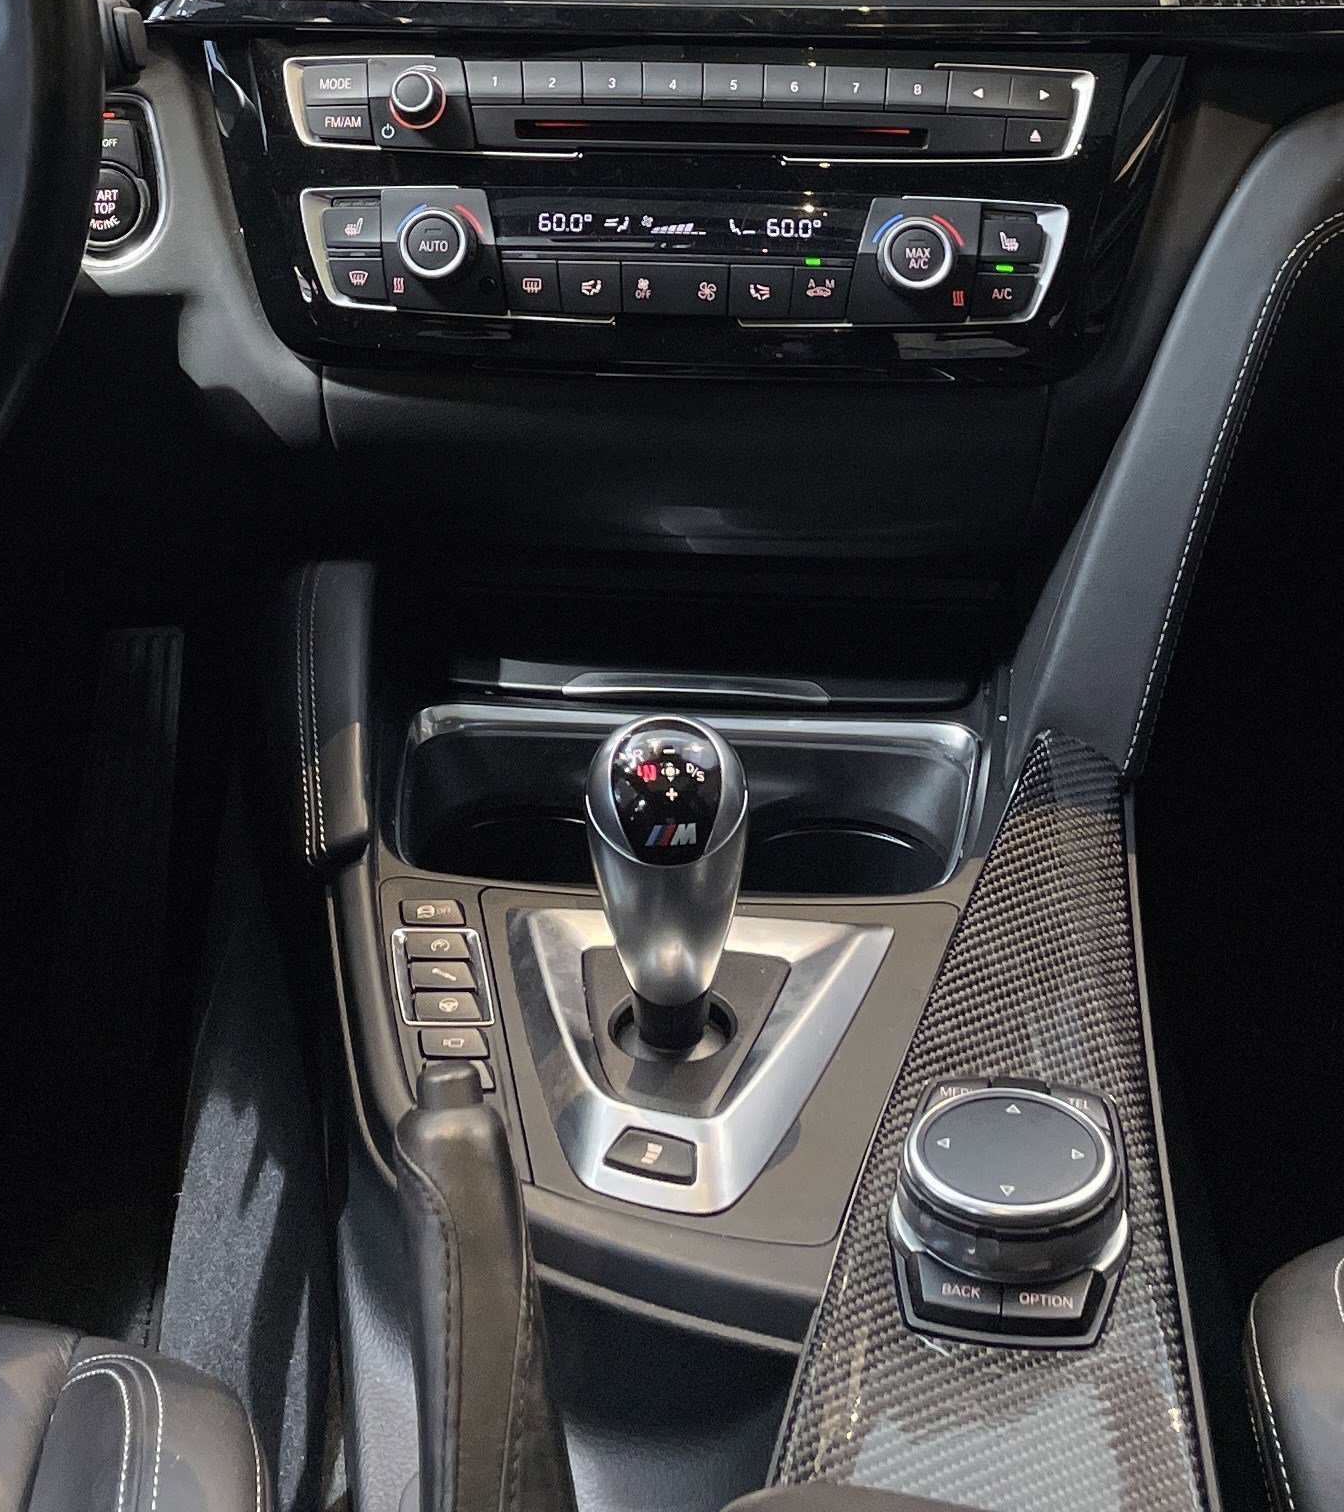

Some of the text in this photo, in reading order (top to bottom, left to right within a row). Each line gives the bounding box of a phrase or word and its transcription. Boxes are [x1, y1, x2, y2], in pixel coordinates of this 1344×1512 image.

[319, 78, 352, 90] MODE
[492, 77, 498, 87] 1
[549, 78, 556, 88] 2
[608, 78, 616, 88] 3
[668, 79, 677, 89] 4
[729, 80, 738, 91] 5
[790, 81, 798, 92] 6
[853, 83, 860, 93] 7
[913, 84, 921, 95] 8
[325, 116, 361, 129] FM/AM
[96, 190, 118, 201] ART
[94, 203, 115, 214] TOP
[90, 215, 120, 230] NGINE
[419, 240, 448, 253] AUTO
[905, 247, 931, 259] MAX
[909, 257, 928, 270] A/C
[635, 289, 651, 299] OFF
[992, 287, 1012, 300] A/C
[686, 763, 705, 782] D/S
[939, 1086, 973, 1097] MED
[1068, 1097, 1089, 1110] TEL
[942, 1282, 980, 1299] BACK
[1019, 1292, 1074, 1309] OPTION
